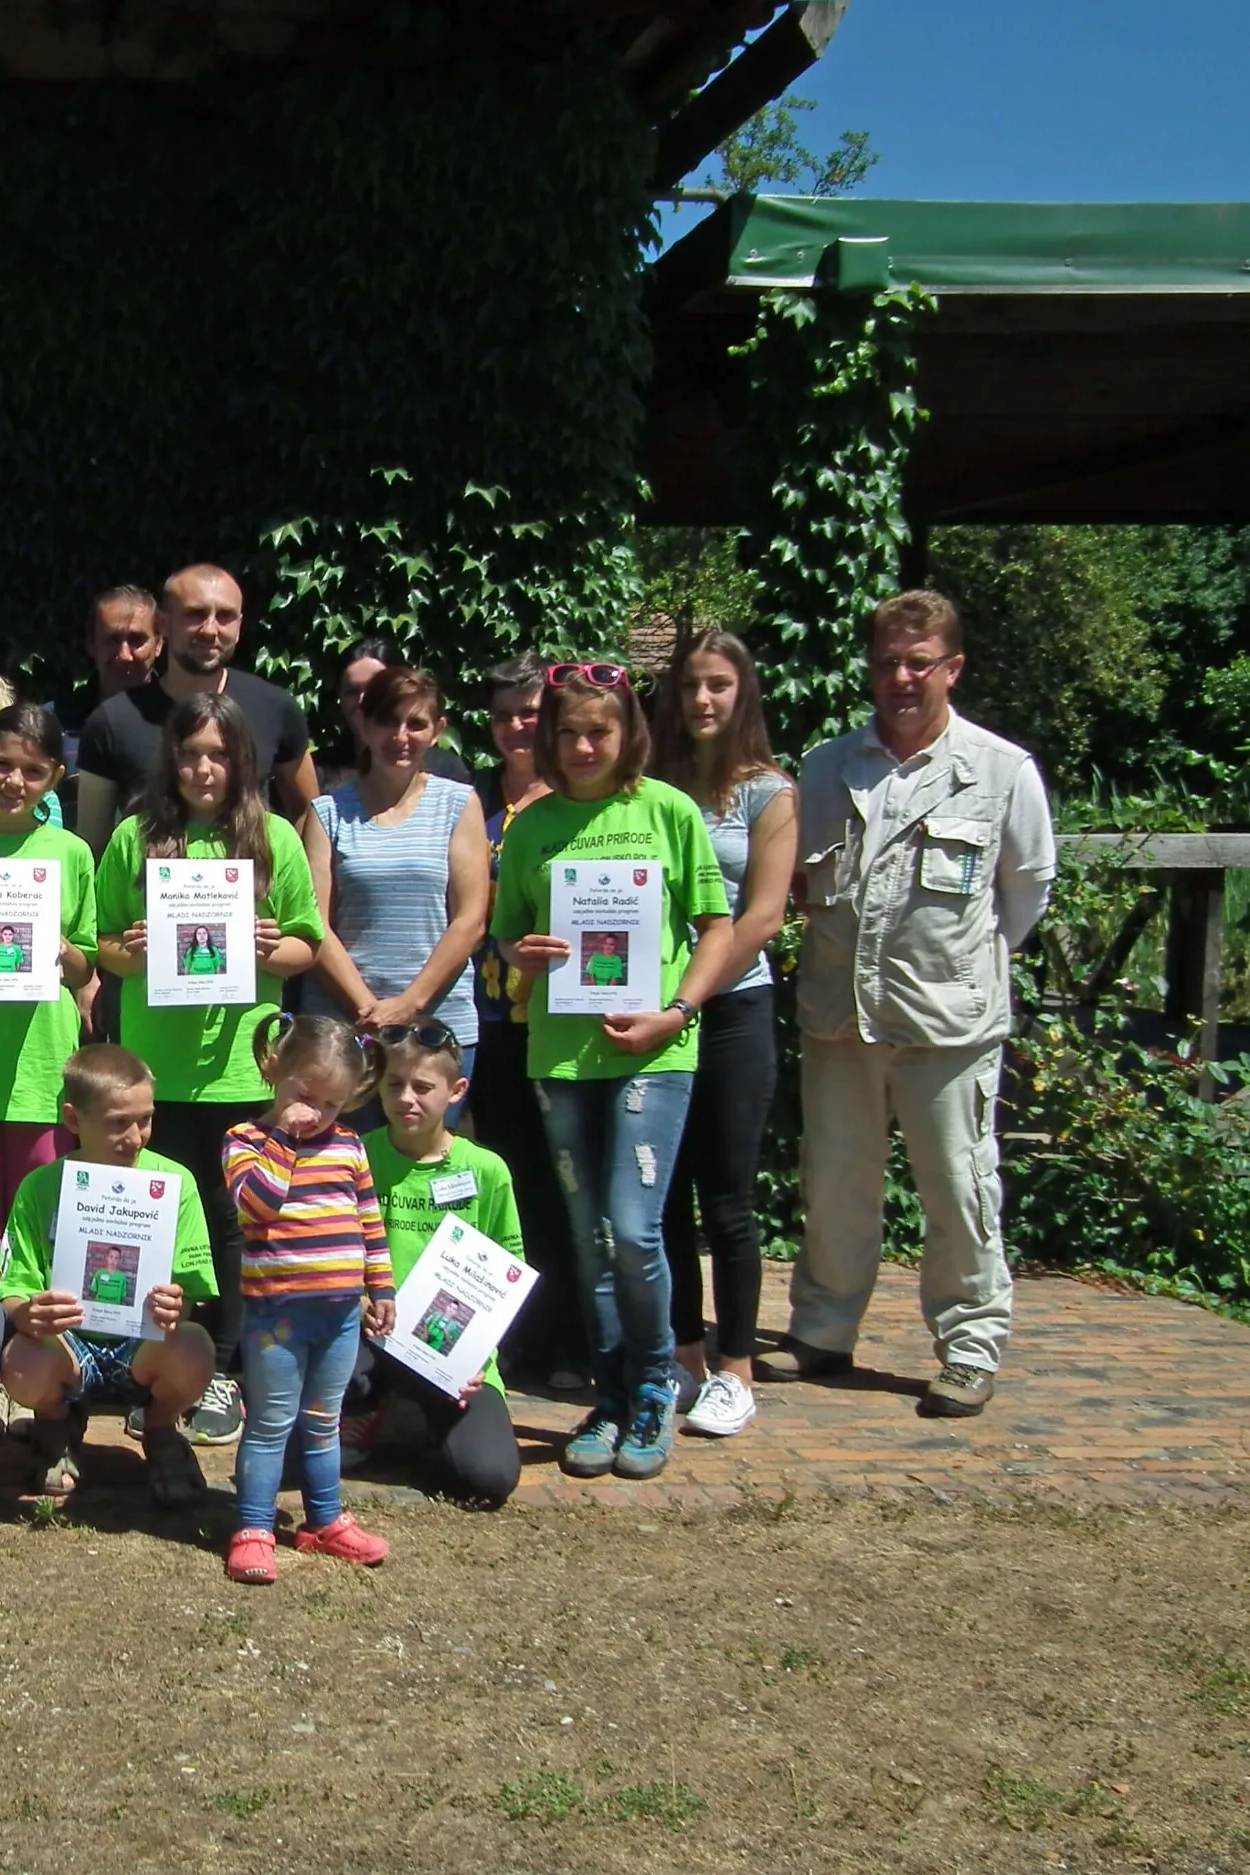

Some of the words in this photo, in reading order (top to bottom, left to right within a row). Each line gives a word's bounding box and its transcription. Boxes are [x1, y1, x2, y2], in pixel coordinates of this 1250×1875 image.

[606, 832, 652, 847] PRIRODE
[6, 891, 44, 900] Koberac
[160, 892, 190, 900] Monika
[194, 892, 239, 900] Matleković
[573, 897, 608, 906] Natalia
[612, 896, 639, 906] Radić
[392, 1191, 426, 1211] ČUVAR
[76, 1202, 105, 1214] David
[110, 1205, 159, 1220] Jakupović
[386, 1218, 416, 1231] RIRODE
[418, 1221, 440, 1233] LONJ
[78, 1226, 103, 1236] MLADI
[106, 1230, 152, 1241] NADZORNIK
[440, 1250, 460, 1268] Luka
